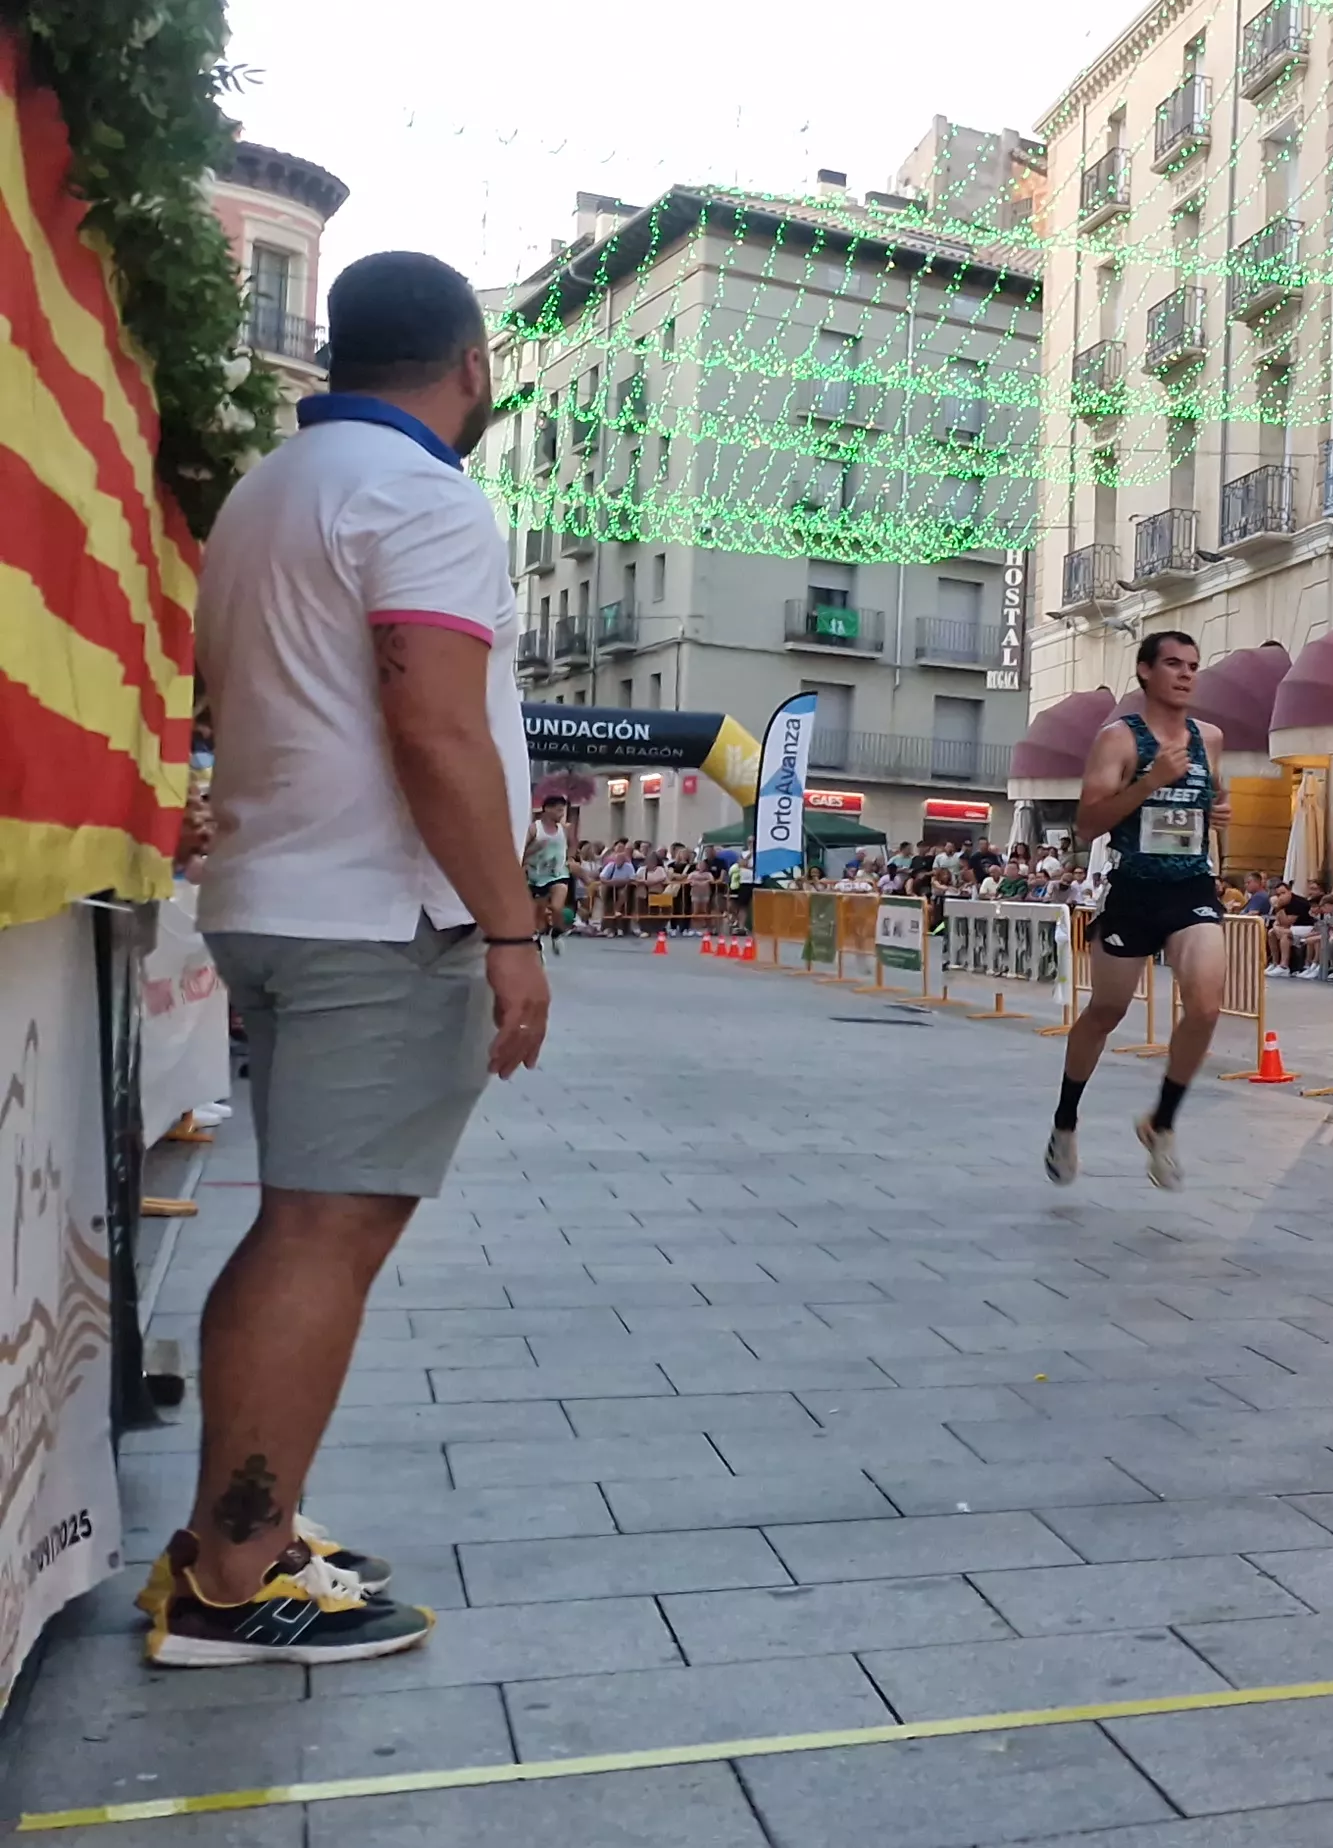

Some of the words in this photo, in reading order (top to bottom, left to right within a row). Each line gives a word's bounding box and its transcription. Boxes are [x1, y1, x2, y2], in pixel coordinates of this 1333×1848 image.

[1001, 548, 1023, 667] HOSTAL
[524, 717, 650, 741] UNDACIÓN
[586, 744, 608, 755] DE
[614, 745, 684, 758] ARAGÓN
[769, 718, 802, 842] OrtoAvanza
[1164, 808, 1188, 825] 13
